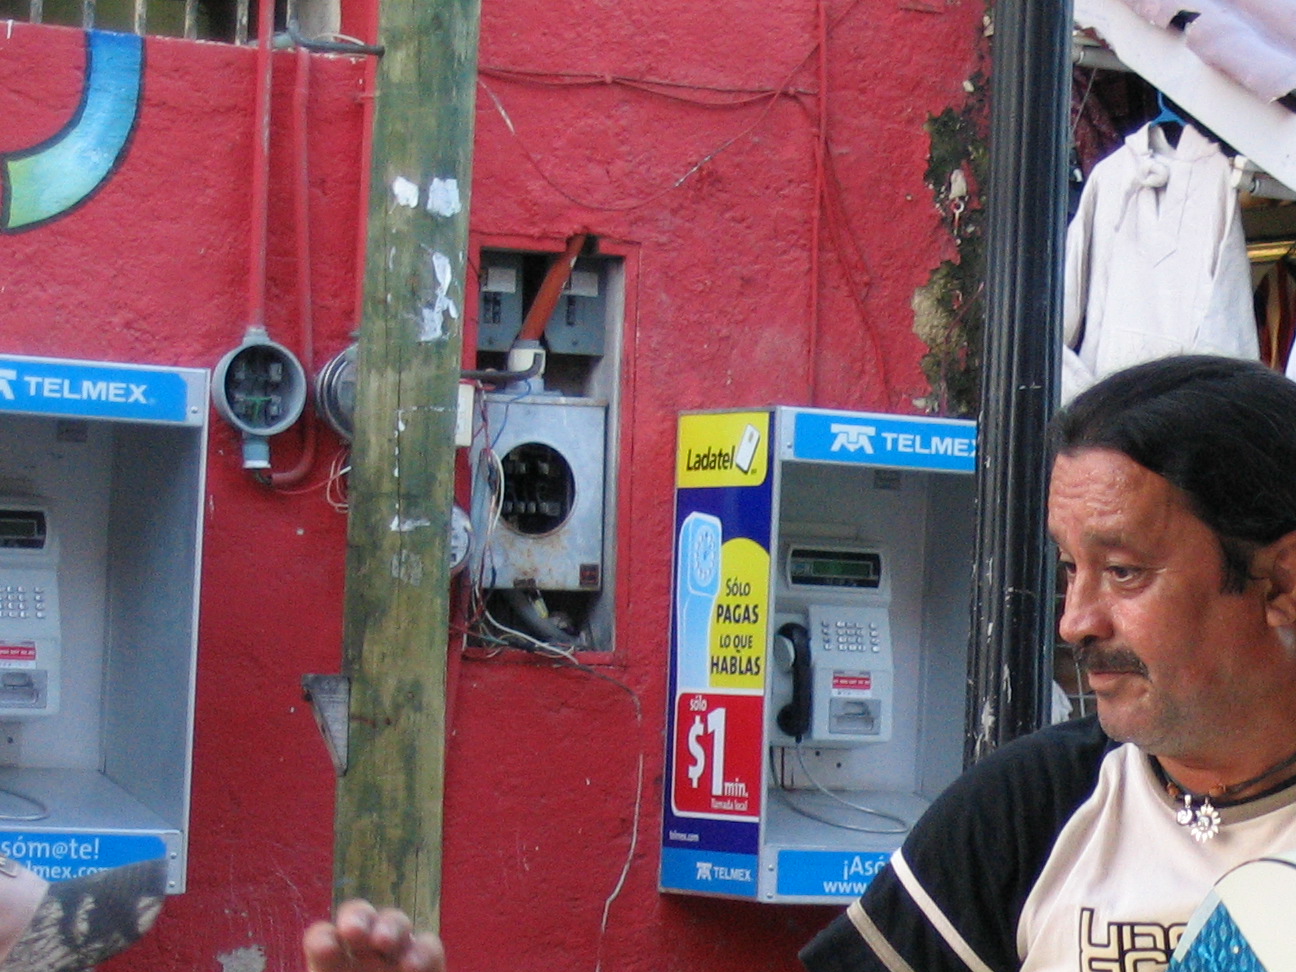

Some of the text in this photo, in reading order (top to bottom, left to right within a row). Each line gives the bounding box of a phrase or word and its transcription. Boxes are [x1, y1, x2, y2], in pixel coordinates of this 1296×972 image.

[24, 376, 148, 404] TELMEX
[881, 432, 976, 457] TELME
[686, 445, 735, 471] Ladatel
[726, 576, 751, 597] SÓLO
[716, 604, 759, 624] PAGAS
[719, 634, 753, 653] LO QUE
[711, 656, 761, 676] HABLAS
[690, 695, 707, 711] sólo
[688, 708, 749, 798] $1 min.
[713, 866, 752, 882] TELMEX
